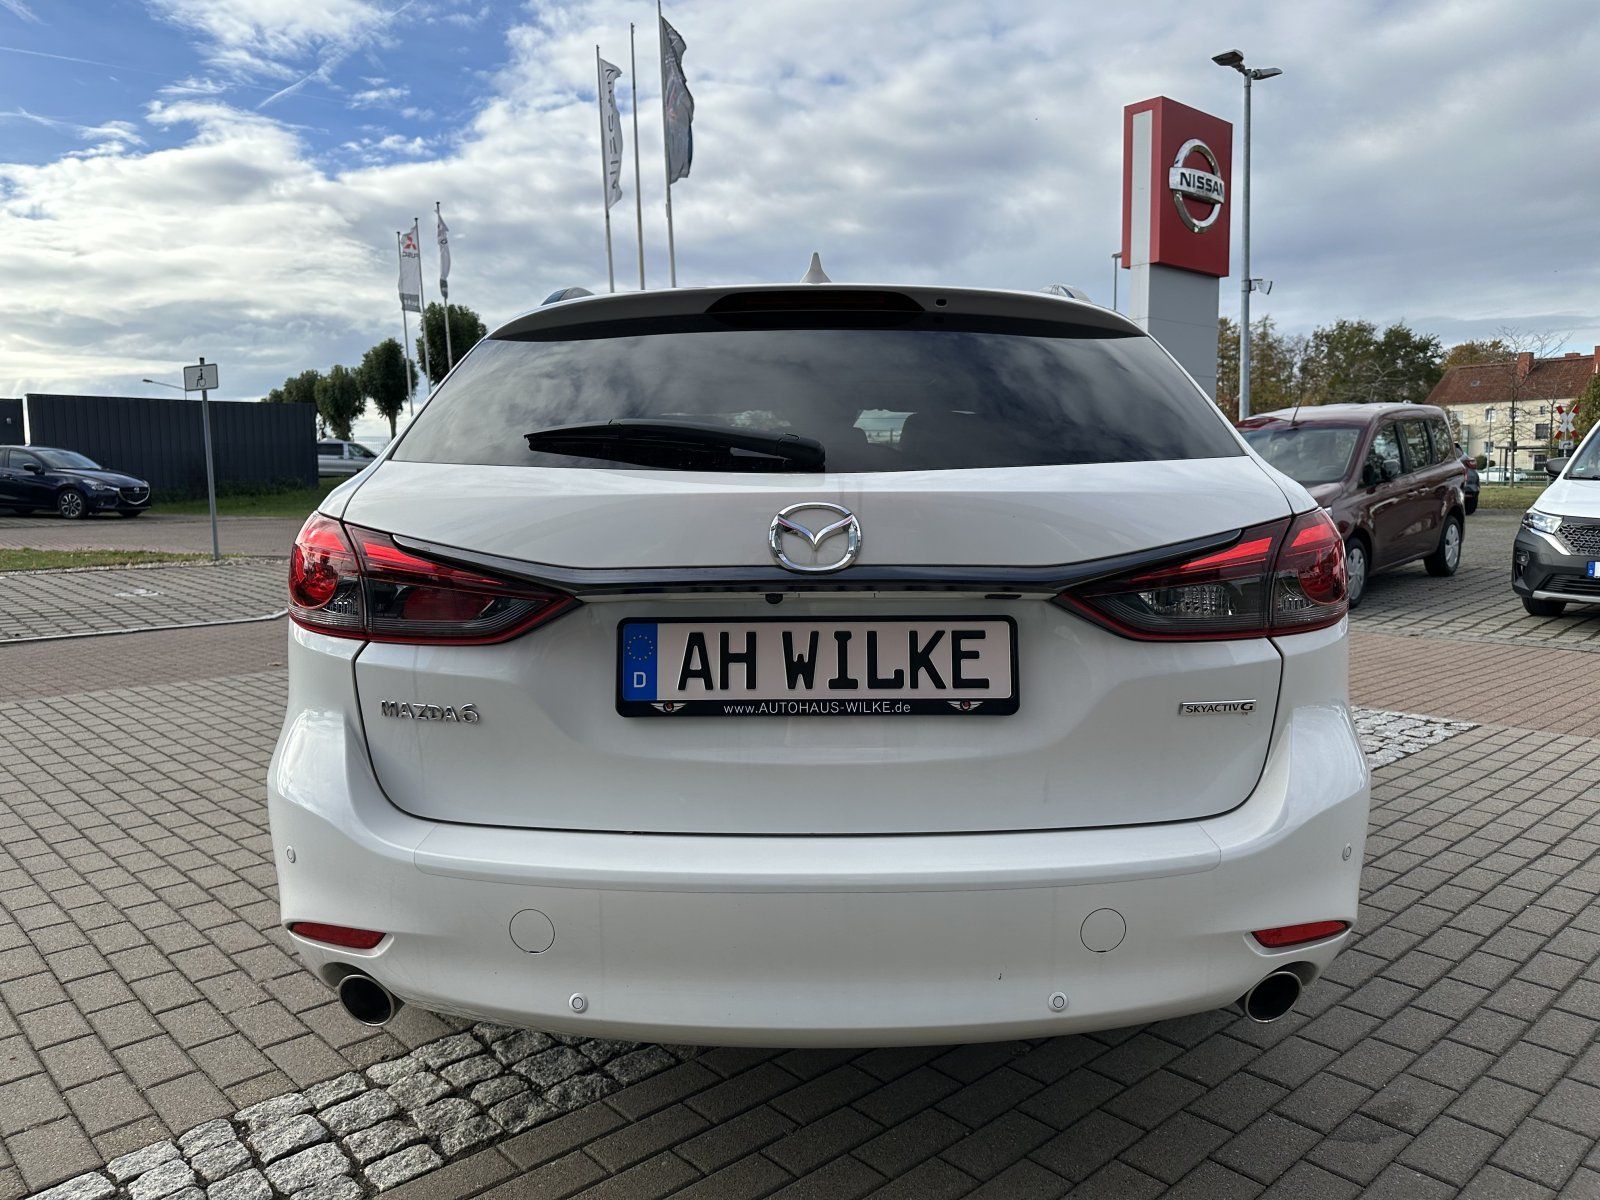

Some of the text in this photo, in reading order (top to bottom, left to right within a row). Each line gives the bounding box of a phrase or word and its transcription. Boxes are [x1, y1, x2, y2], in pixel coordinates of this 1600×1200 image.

[677, 629, 990, 691] AH WILKE
[633, 671, 647, 688] D
[723, 701, 911, 714] www.AUTOHAUS-WILKE.de
